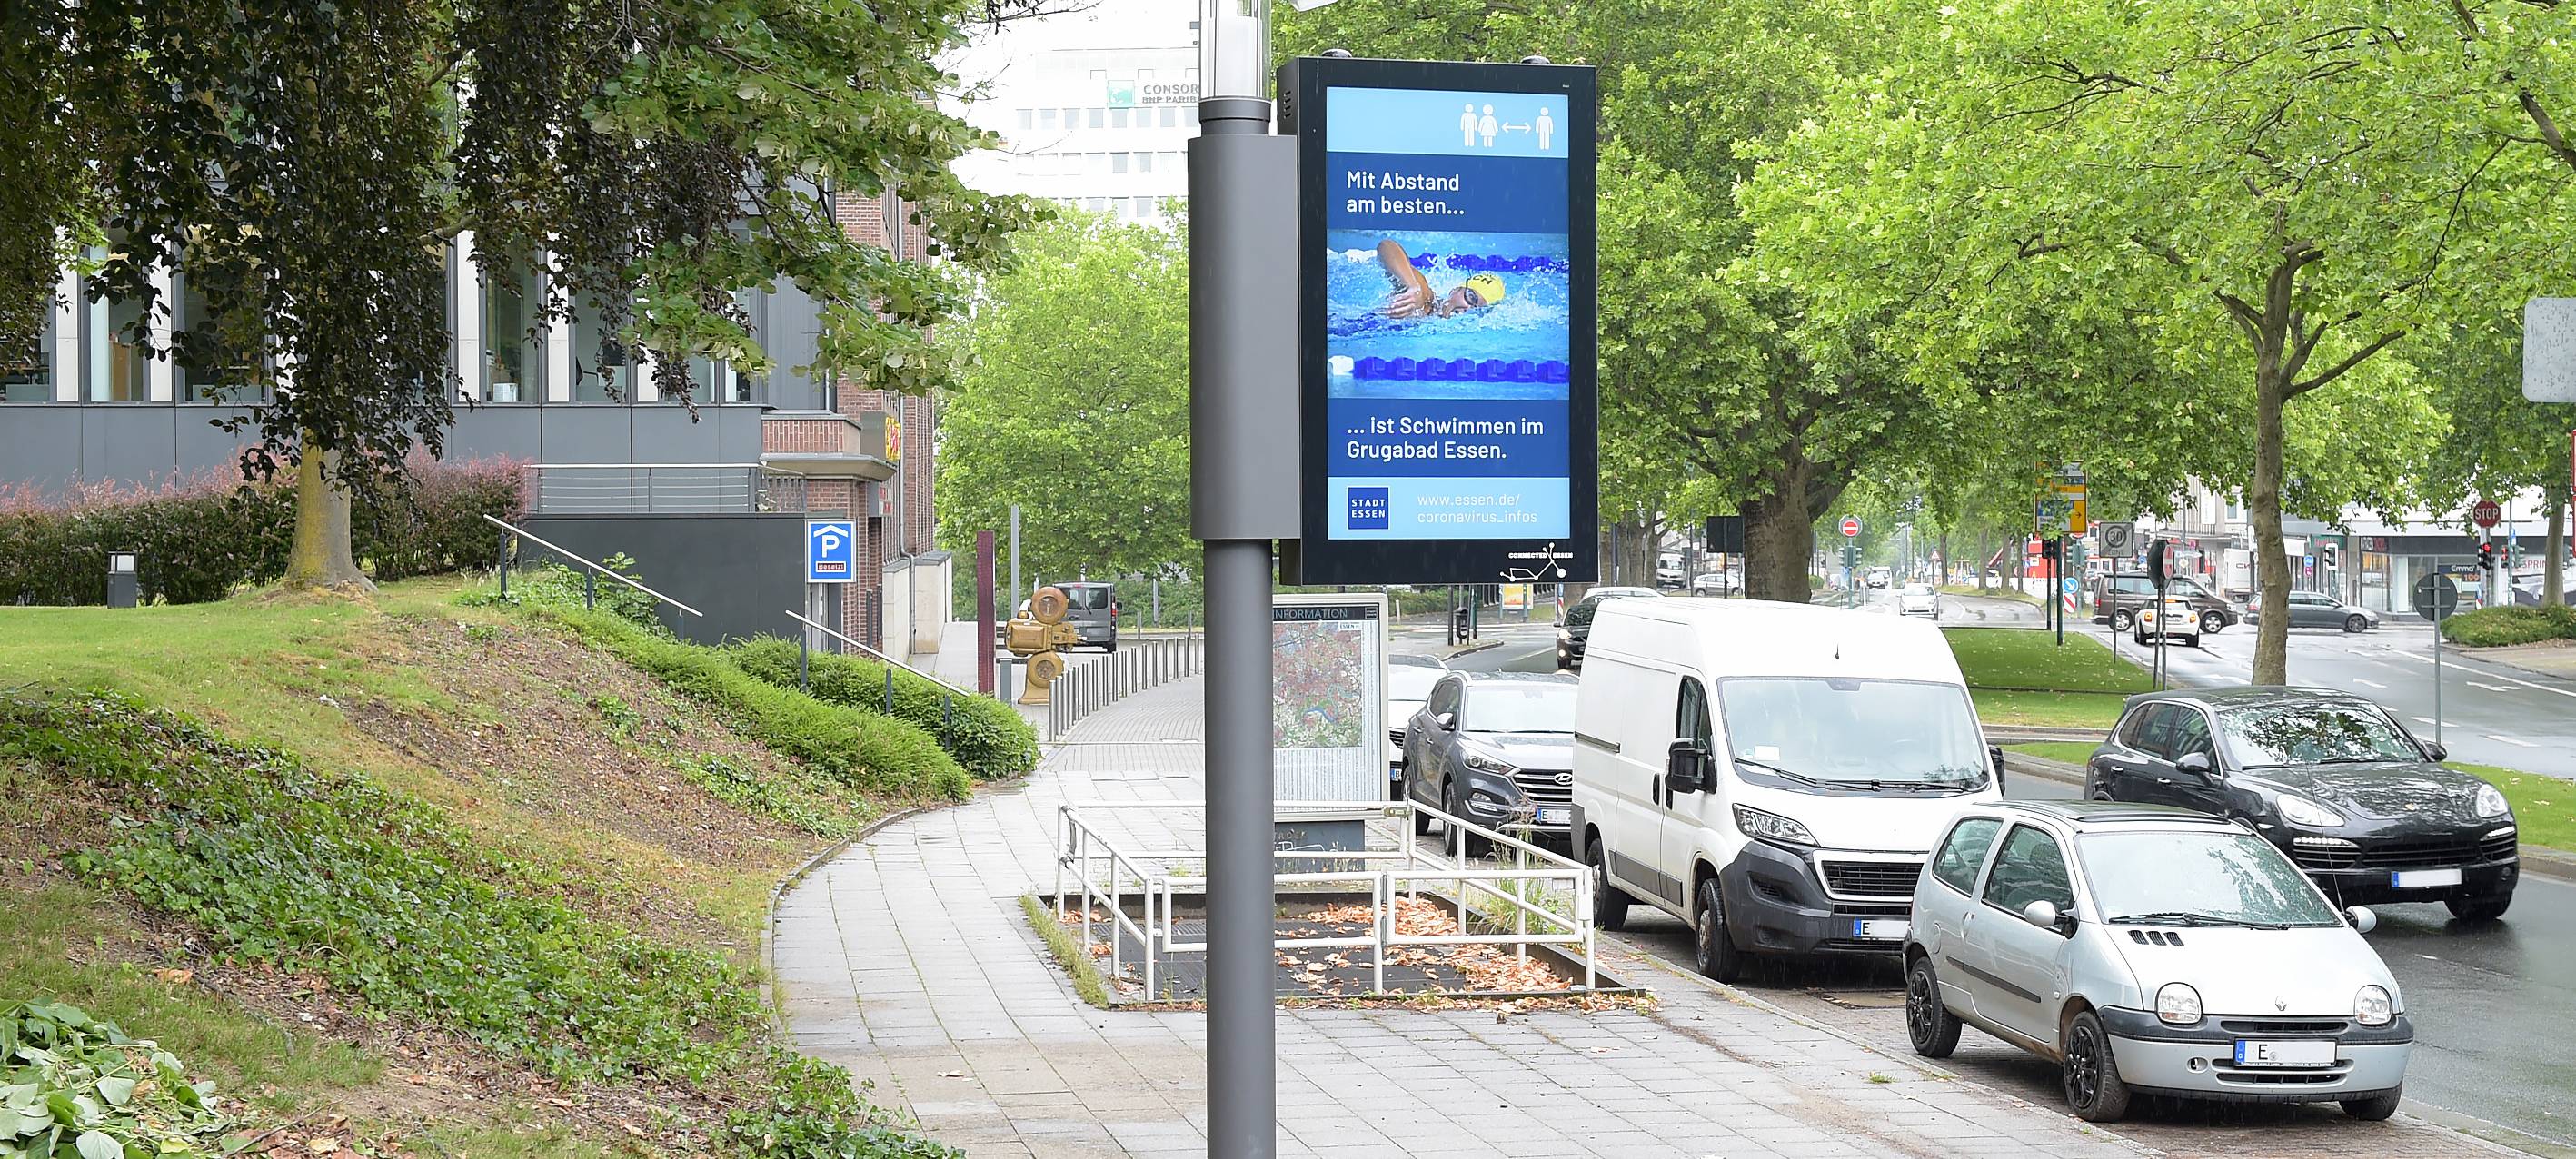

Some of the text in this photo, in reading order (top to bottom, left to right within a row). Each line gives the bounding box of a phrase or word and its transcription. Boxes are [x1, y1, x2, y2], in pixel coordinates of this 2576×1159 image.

[1166, 95, 1199, 104] PARIB
[1347, 171, 1459, 192] Mit Abstand
[1346, 195, 1465, 215] am besten...
[1370, 416, 1395, 434] ist
[1399, 416, 1516, 435] Schwimmen
[1520, 417, 1544, 435] im
[1347, 441, 1507, 462] Grugabad Essen.
[1351, 499, 1386, 507] STADT
[1417, 493, 1520, 506] www.essen.de/
[1351, 510, 1386, 518] ESSEN
[1417, 510, 1538, 523] coronavirus_infos
[2474, 508, 2499, 520] STOP
[2109, 530, 2123, 542] 30
[821, 534, 840, 559] P
[1272, 609, 1348, 619] INFORMATION
[1542, 810, 1547, 819] E
[1862, 922, 1871, 935] E
[2258, 1044, 2268, 1060] E
